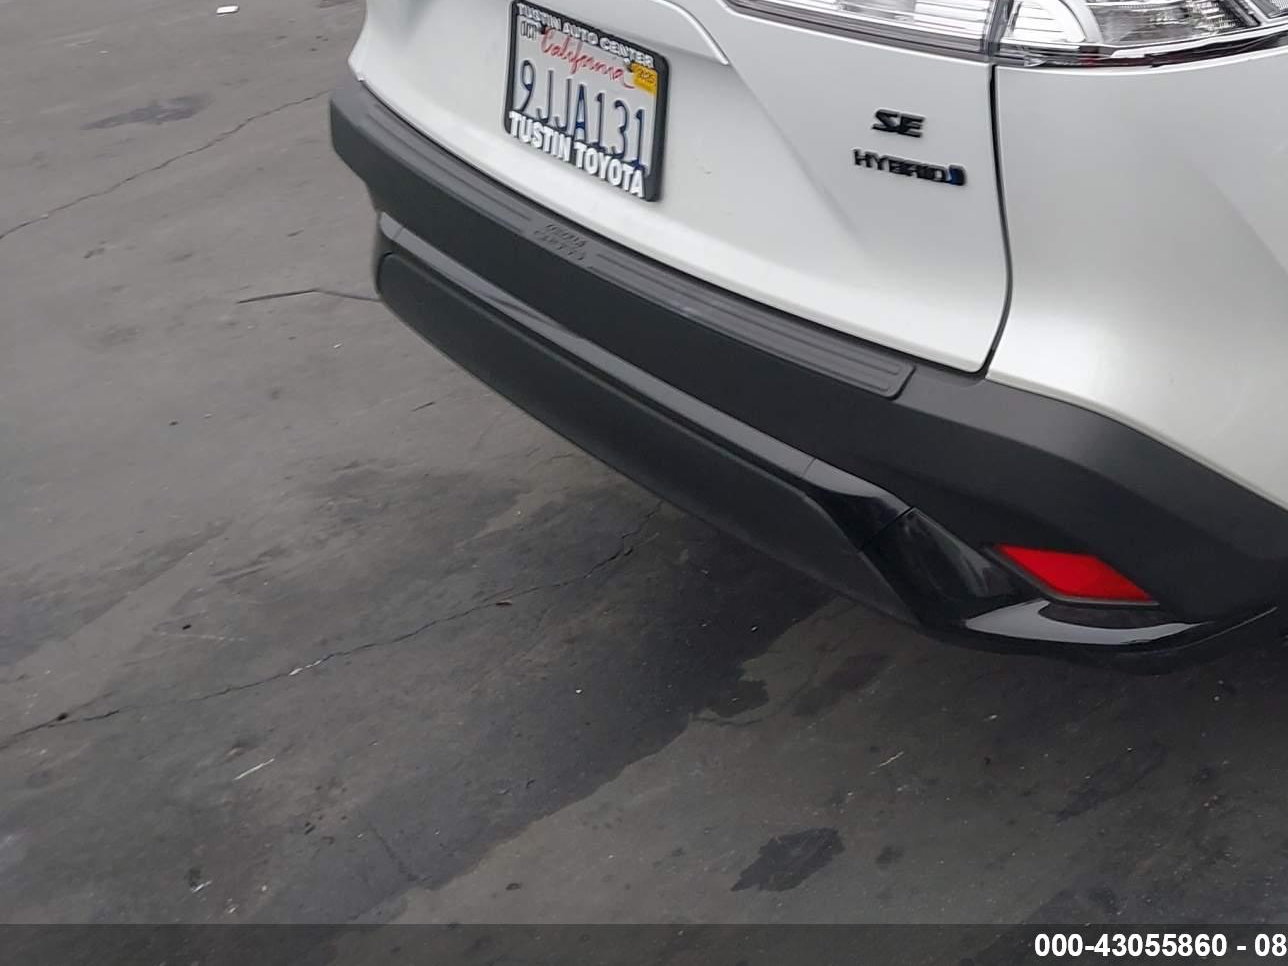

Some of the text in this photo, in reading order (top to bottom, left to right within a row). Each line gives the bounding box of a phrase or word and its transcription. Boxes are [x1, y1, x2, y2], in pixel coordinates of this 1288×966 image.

[517, 3, 561, 29] TUSTIN
[562, 21, 598, 45] AUTO
[600, 38, 653, 68] CENTER
[540, 26, 624, 81] California
[521, 59, 646, 168] 9JJA131
[872, 108, 926, 138] SE
[509, 110, 645, 197] TUSTIN TOYOTA
[852, 148, 950, 184] HYBRID
